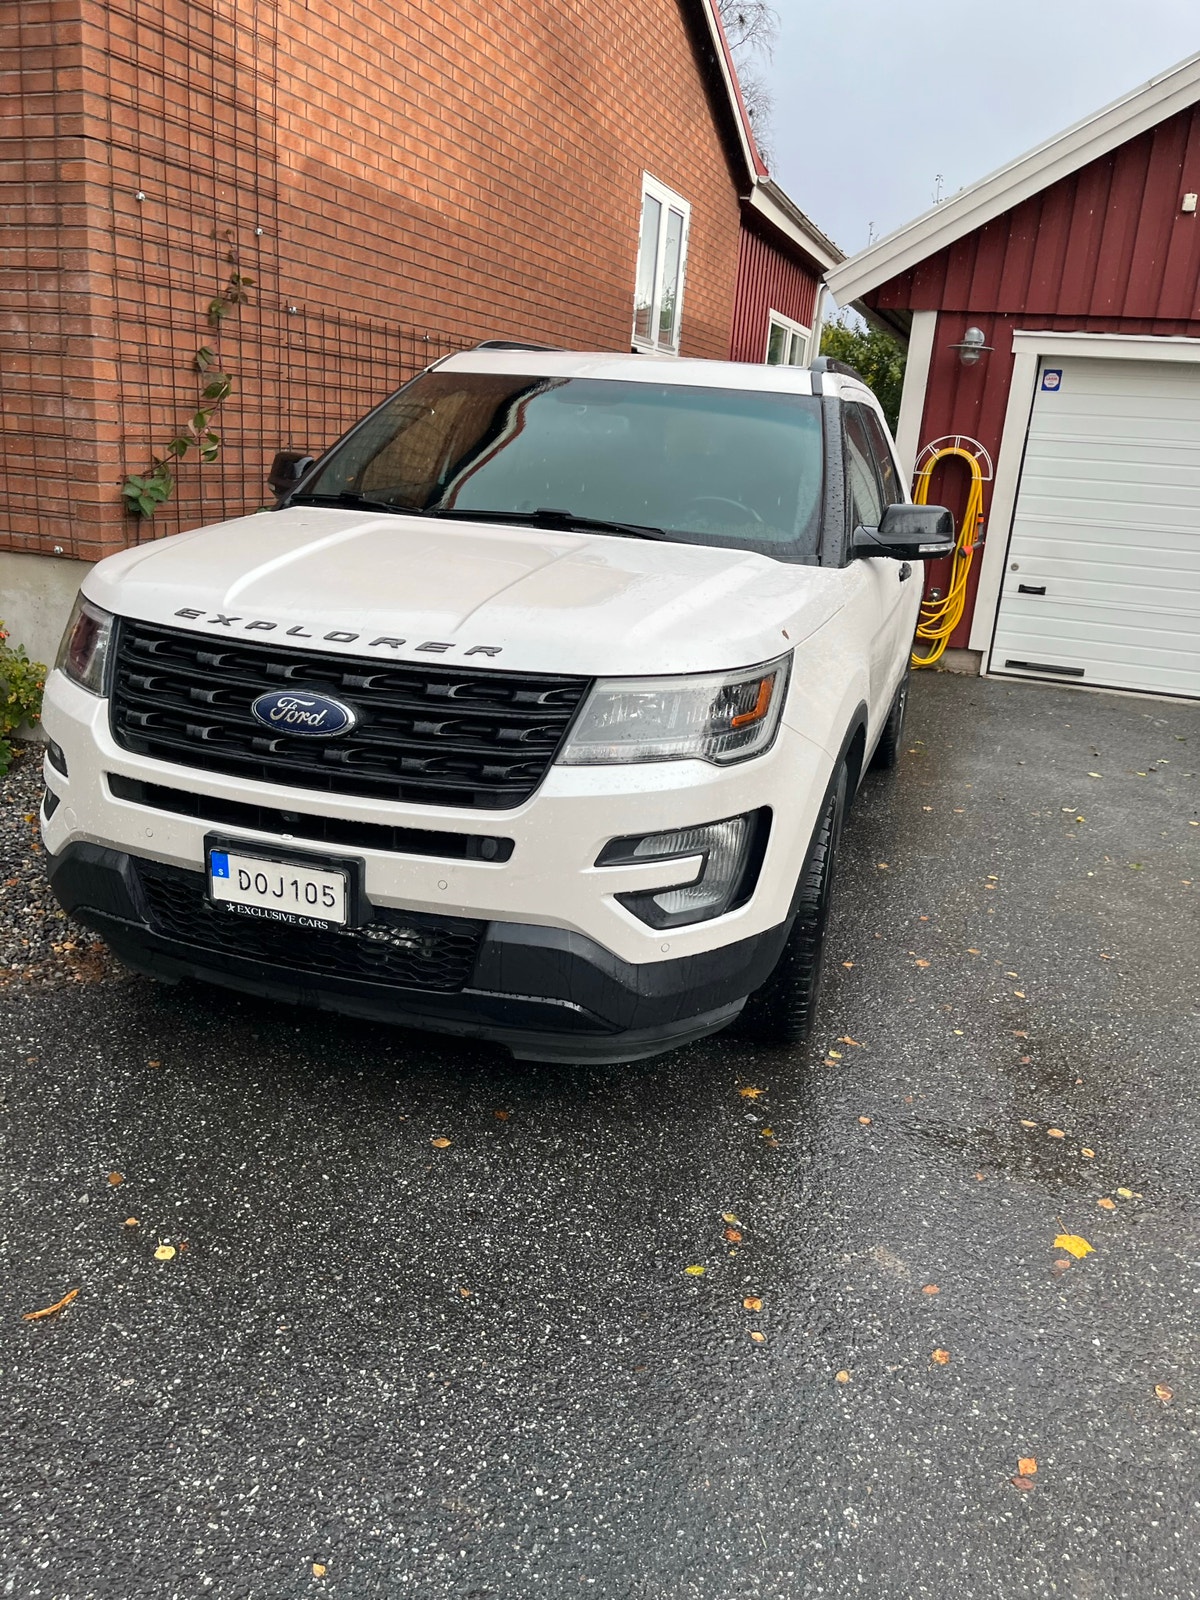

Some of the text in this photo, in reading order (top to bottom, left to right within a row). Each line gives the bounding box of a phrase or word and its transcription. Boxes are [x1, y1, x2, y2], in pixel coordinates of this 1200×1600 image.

[174, 607, 503, 657] EXPLORER
[269, 696, 327, 727] Ford
[218, 868, 224, 876] S
[238, 869, 335, 907] DOJ105
[237, 904, 329, 930] EXCLUSIVE CARS
